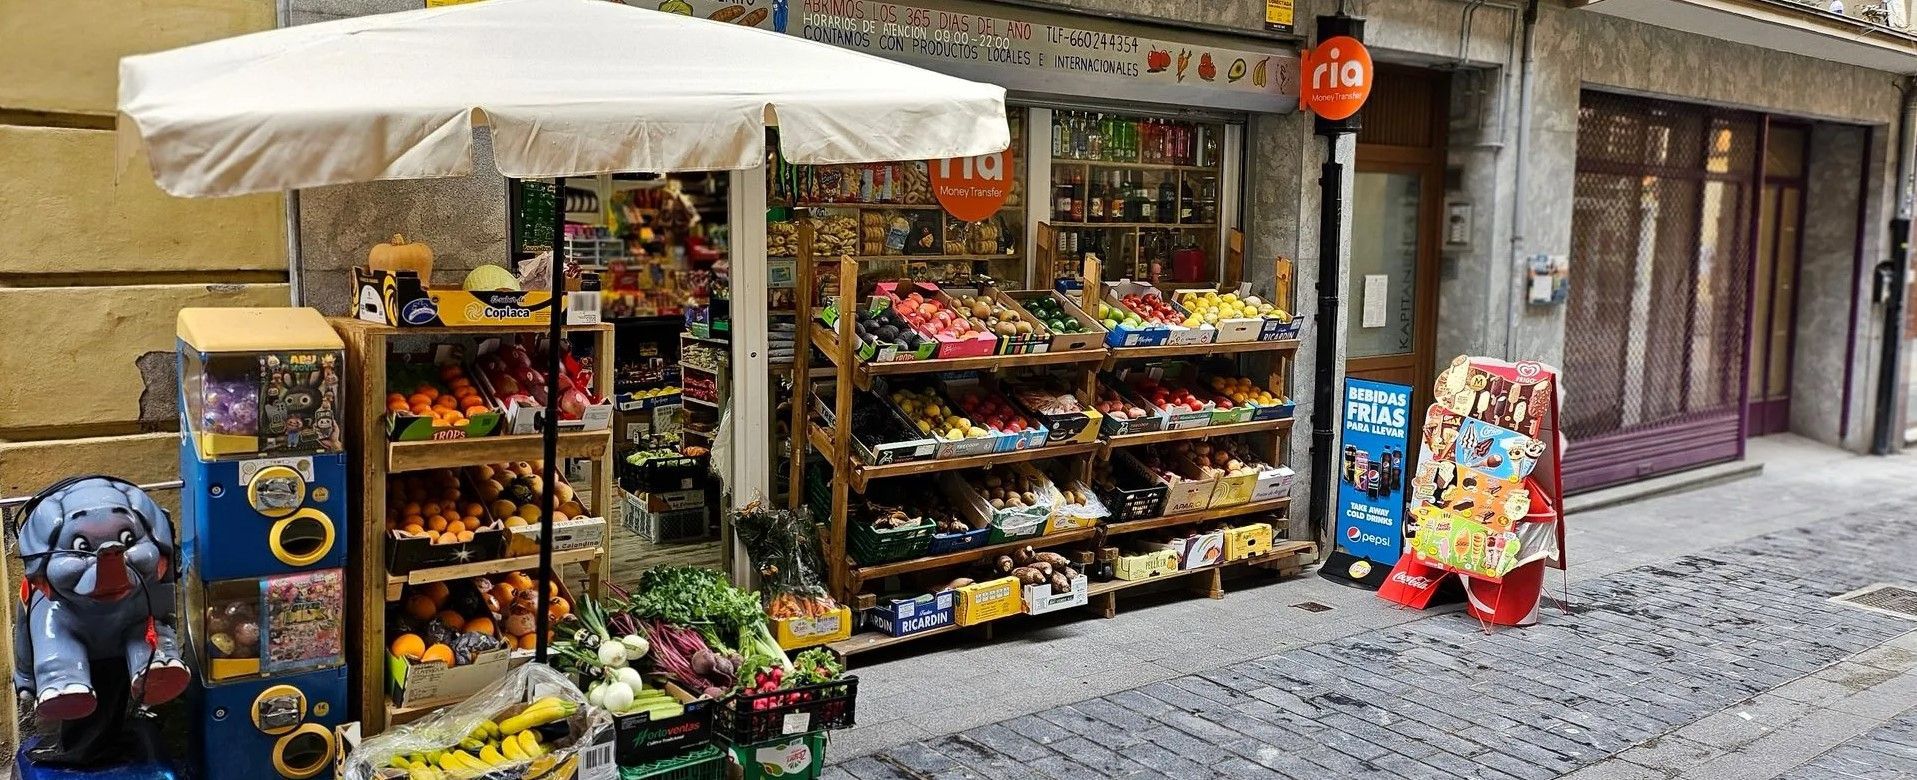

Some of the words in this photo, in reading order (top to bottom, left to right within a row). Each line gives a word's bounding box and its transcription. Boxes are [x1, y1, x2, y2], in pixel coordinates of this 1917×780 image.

[803, 12, 857, 31] HORARIOS
[863, 20, 875, 33] DE
[883, 23, 927, 40] ATENCION
[804, 0, 864, 19] ABRIMOS
[873, 3, 897, 22] LOS
[905, 8, 930, 27] 365
[940, 12, 969, 32] DIAS
[978, 17, 999, 36] DEL
[1007, 21, 1031, 40] AÑO
[804, 25, 870, 47] CONTAMOS
[880, 35, 904, 52] CON
[912, 39, 978, 60] PRODUCTOS
[987, 47, 1031, 65] LOCALES
[1039, 53, 1044, 66] E
[1054, 55, 1139, 77] INTERNACIONALES
[1312, 47, 1363, 89] ria
[1312, 94, 1334, 102] Money
[1335, 92, 1362, 101] Transfer
[940, 185, 969, 198] Money
[971, 186, 1002, 197] Transfer
[485, 307, 530, 320] Coplaca
[1263, 331, 1295, 342] RICARDIN
[1349, 386, 1406, 407] BEBIDAS
[1347, 401, 1405, 428] FRÍAS
[433, 430, 465, 440] TROPS
[1346, 421, 1370, 432] PARA
[1371, 425, 1405, 438] LLEVAR
[1351, 502, 1367, 512] TAKE
[1369, 506, 1389, 516] AWAY
[1347, 510, 1365, 520] COLD
[1366, 514, 1392, 526] DRINKS
[1362, 533, 1391, 547] pepsi
[870, 614, 893, 632] ARDIN
[902, 611, 948, 633] RICARDIN
